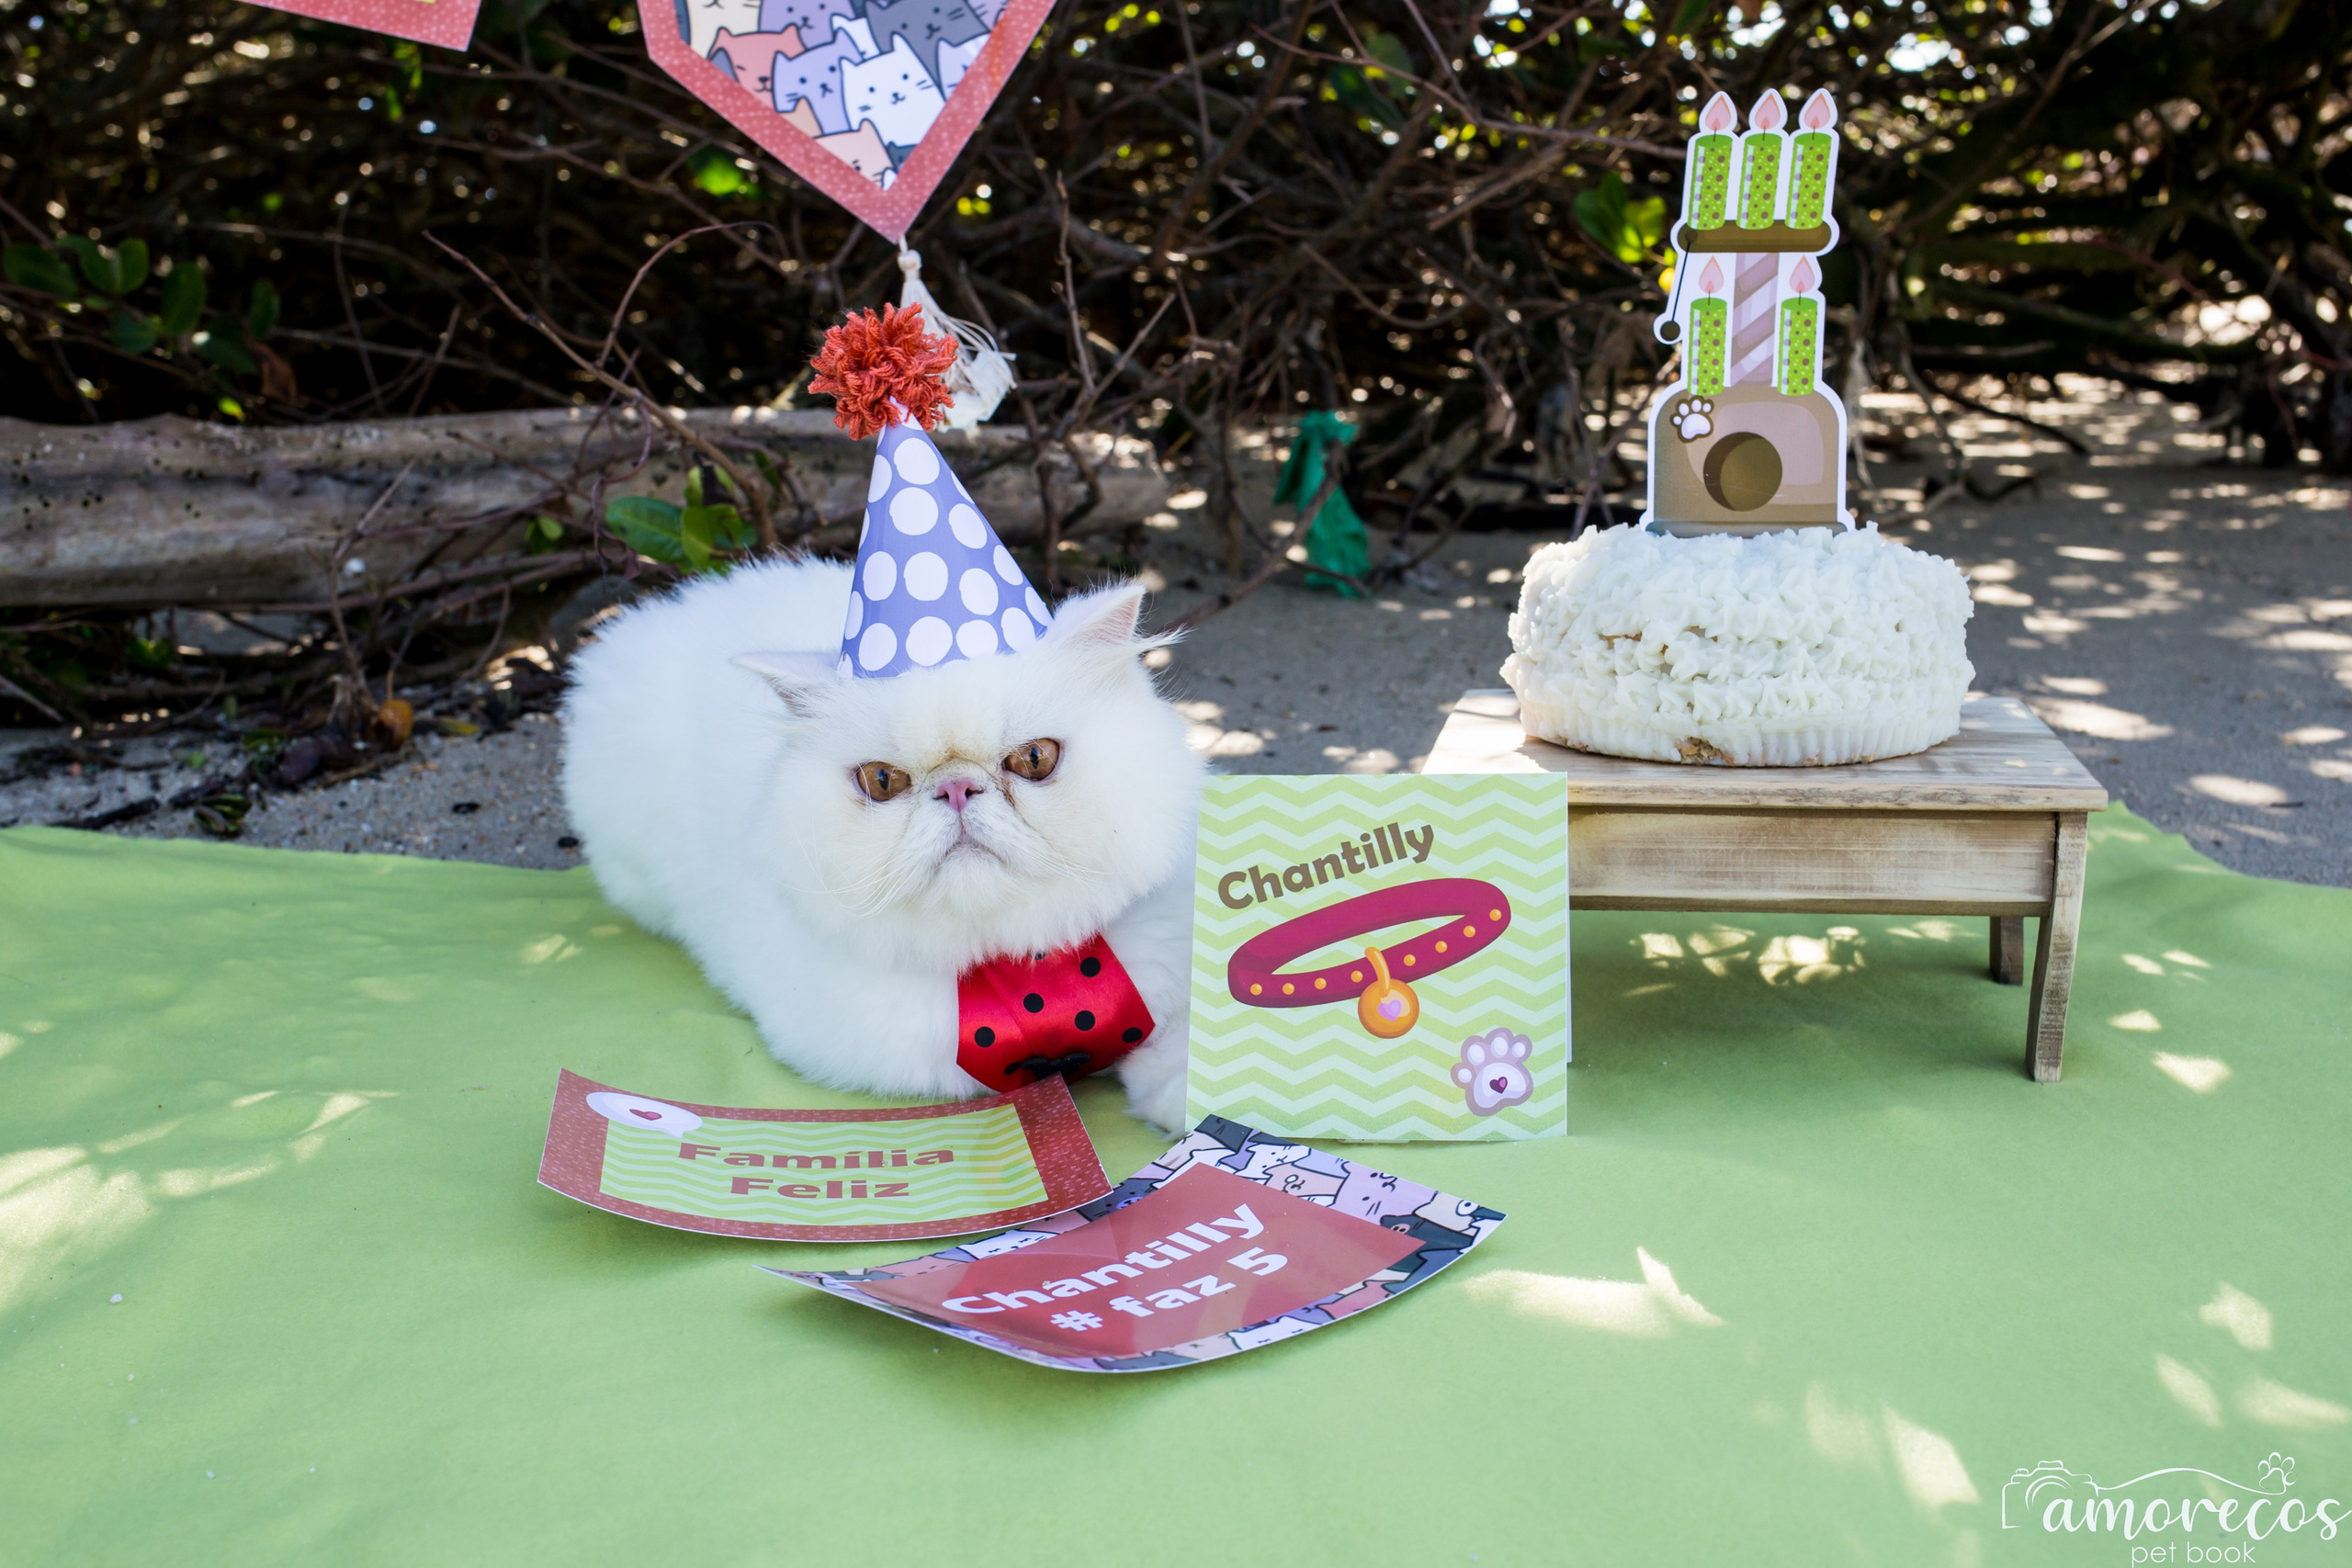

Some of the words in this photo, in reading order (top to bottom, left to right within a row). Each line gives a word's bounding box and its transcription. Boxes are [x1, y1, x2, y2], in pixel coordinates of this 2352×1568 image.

[1217, 821, 1435, 910] Chantilly
[677, 1142, 955, 1170] Família
[729, 1176, 910, 1200] Feliz
[941, 1202, 1265, 1315] Chantilly
[1049, 1308, 1103, 1333] #
[1111, 1274, 1237, 1318] faz
[1238, 1247, 1288, 1277] 5
